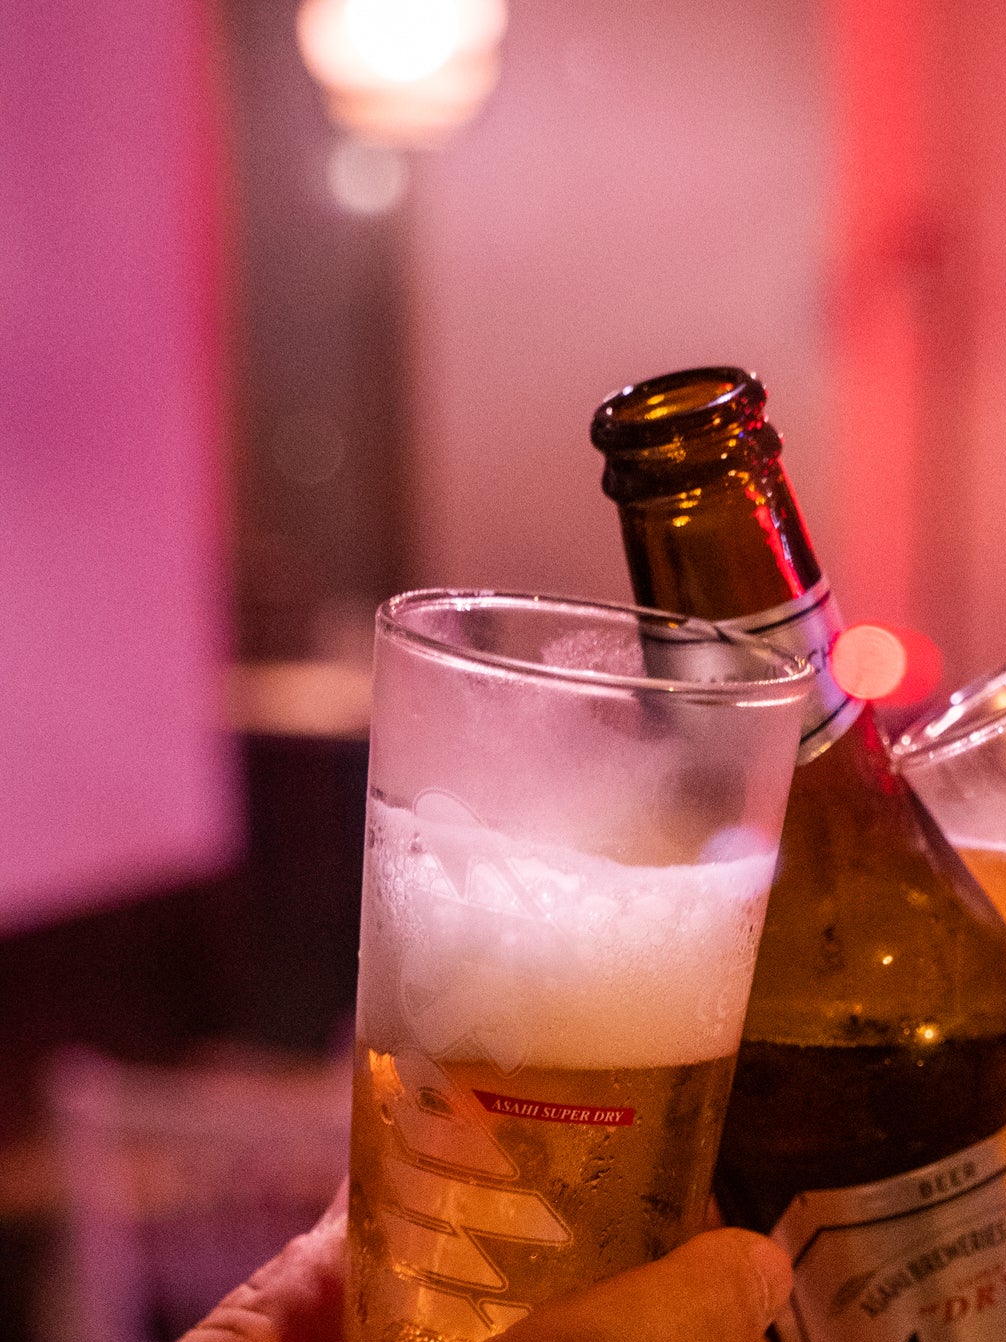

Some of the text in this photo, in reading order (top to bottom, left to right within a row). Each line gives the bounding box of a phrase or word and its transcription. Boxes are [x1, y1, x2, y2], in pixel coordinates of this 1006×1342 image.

[490, 1098, 624, 1123] ASAHI SUPER DRY
[918, 1160, 976, 1199] BEER
